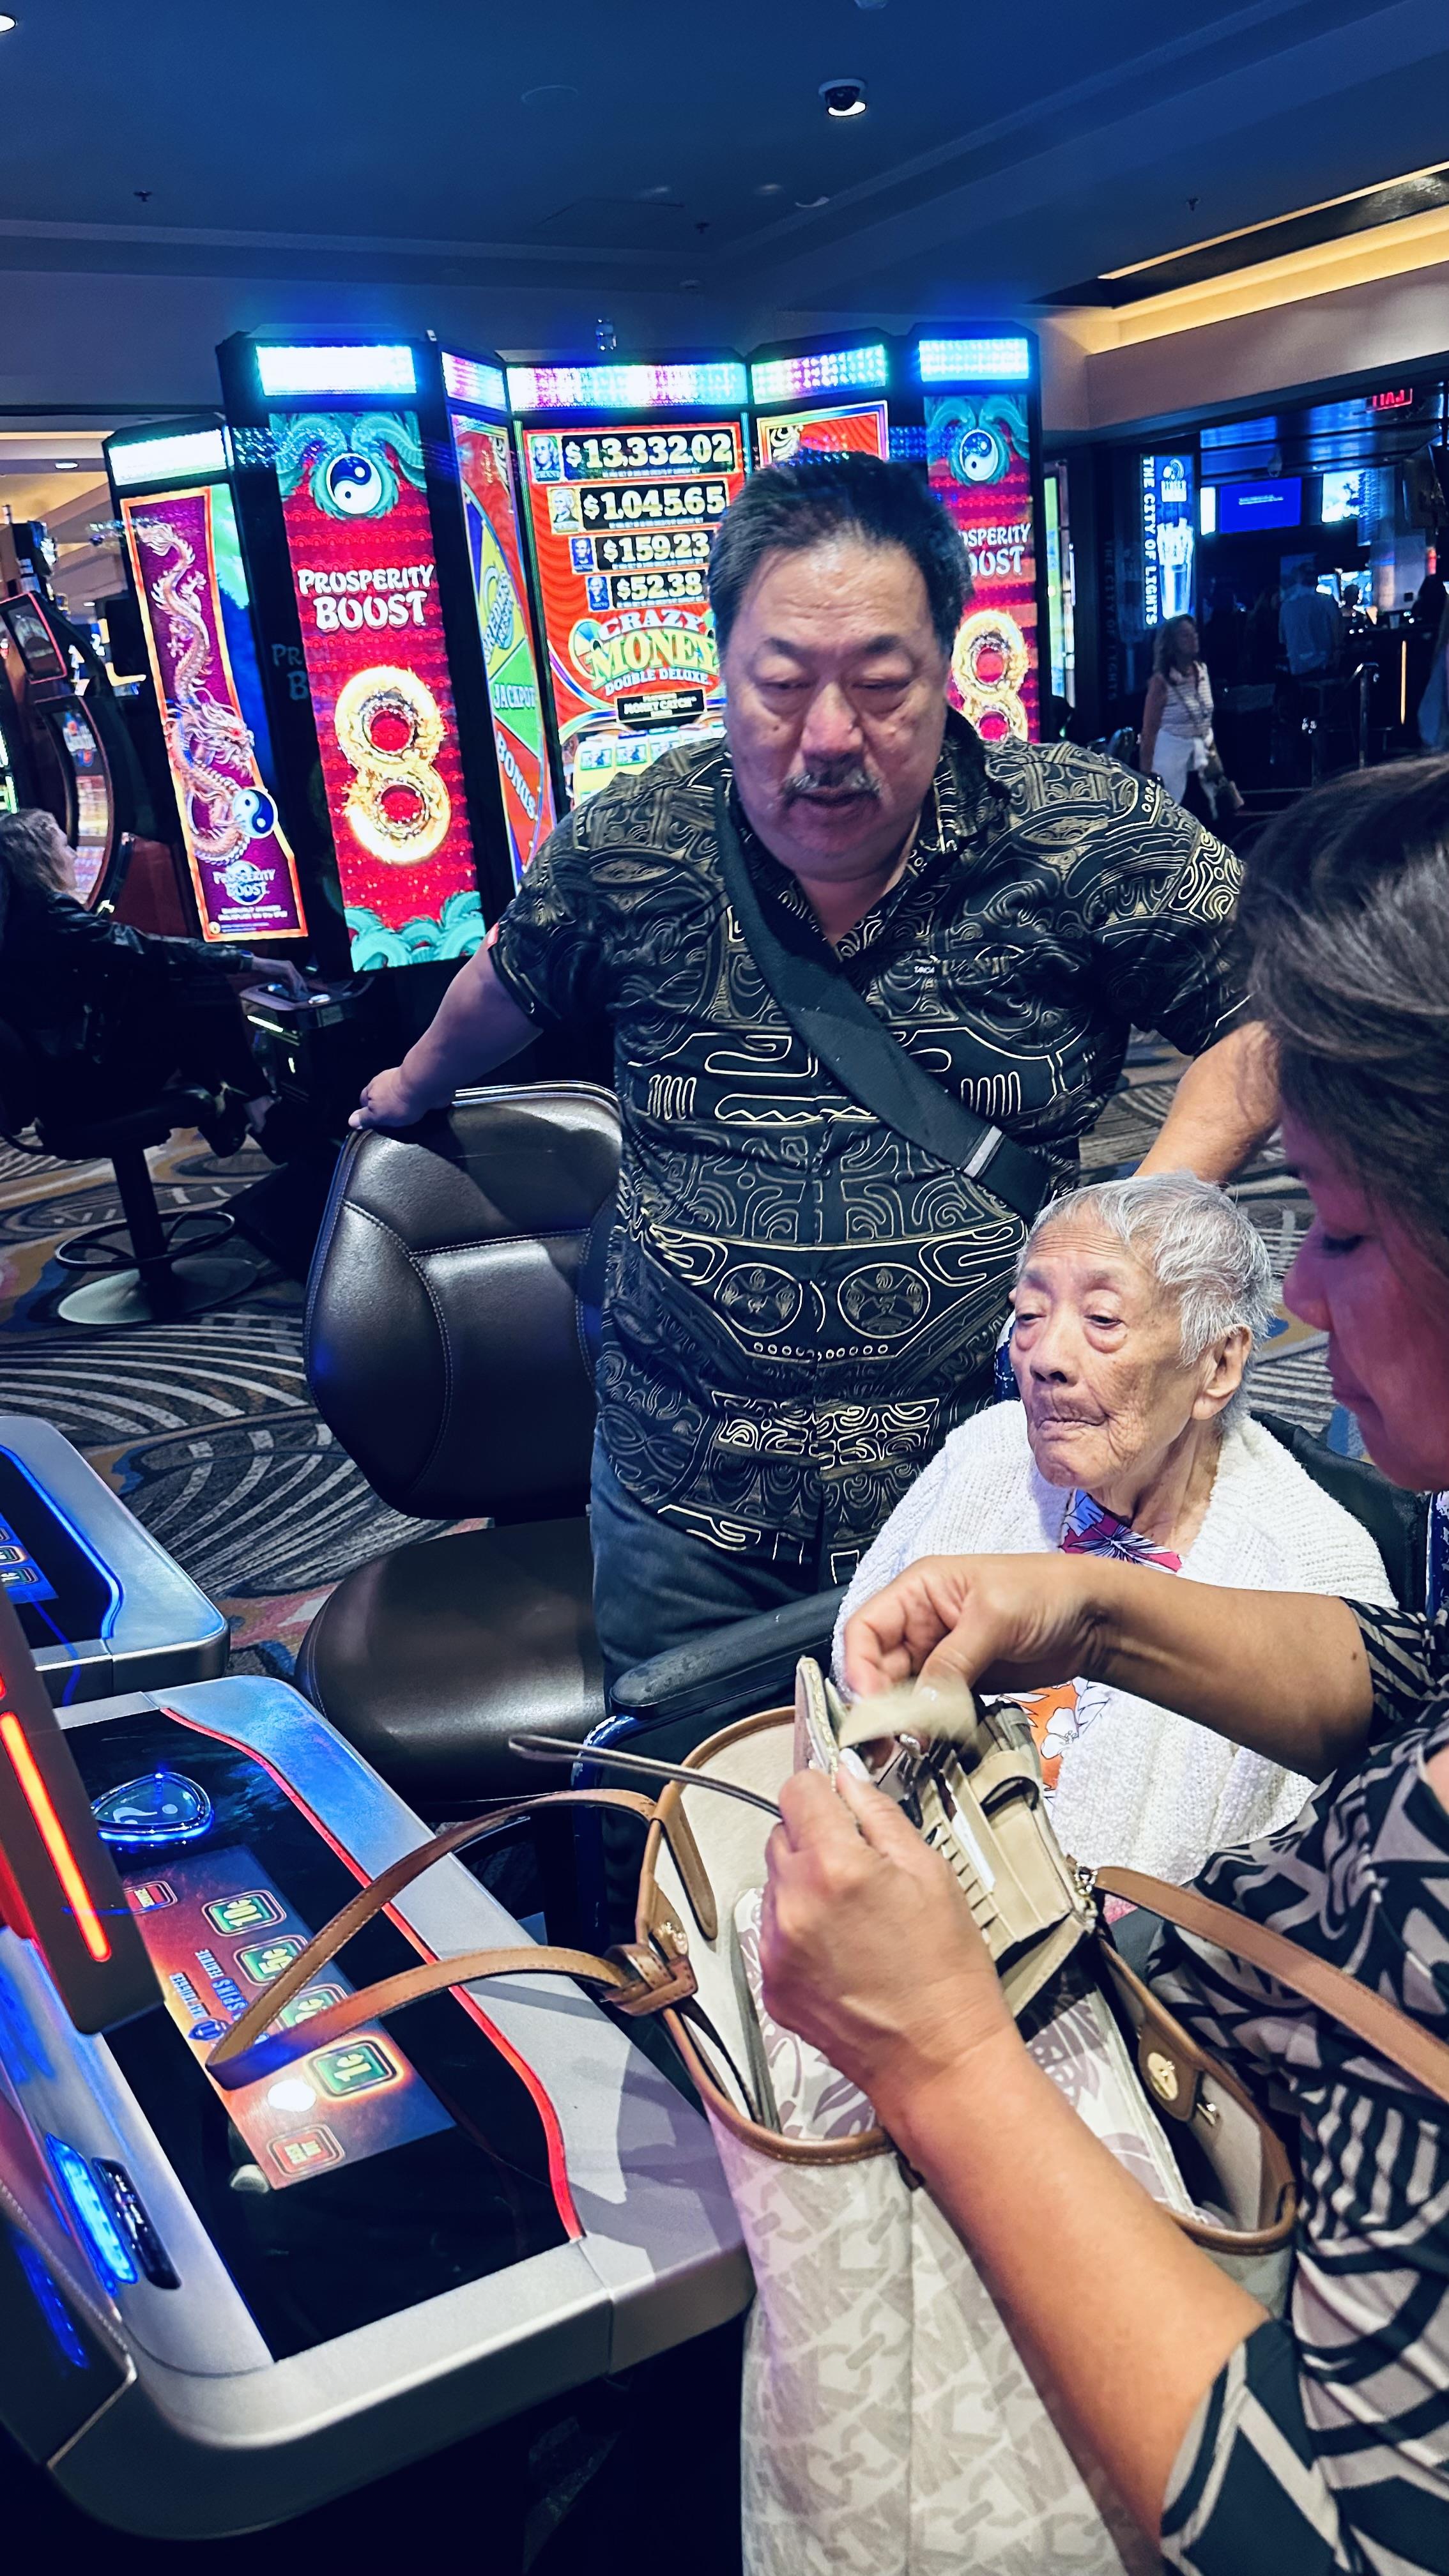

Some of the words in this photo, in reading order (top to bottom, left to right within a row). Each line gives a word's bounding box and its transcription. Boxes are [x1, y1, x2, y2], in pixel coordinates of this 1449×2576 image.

[565, 433, 733, 468] $13,332.02
[1143, 456, 1155, 487] THE
[584, 486, 726, 520] $1,045.65
[1144, 493, 1156, 534] CITY
[603, 532, 710, 563] $159.23
[958, 522, 1031, 548] OSPERITY
[1144, 539, 1156, 561] OF
[297, 564, 434, 595] PROSPERITY
[617, 571, 703, 601] $52.38
[312, 590, 427, 631] BOOST
[1145, 566, 1158, 625] LIGHTS
[599, 609, 704, 641] CRAZY
[585, 627, 720, 691] MONEY
[493, 684, 536, 709] JACKPOT
[604, 668, 657, 696] DOUBLE
[659, 668, 709, 685] DELUXE
[496, 730, 537, 820] BONUS
[223, 1899, 263, 1927] 10¢
[194, 1949, 225, 1979] FEATURE
[257, 1947, 293, 1975] 5¢
[168, 1972, 199, 2005] TRIGGER
[211, 1977, 249, 2012] SPINS
[334, 2053, 372, 2082] 1¢
